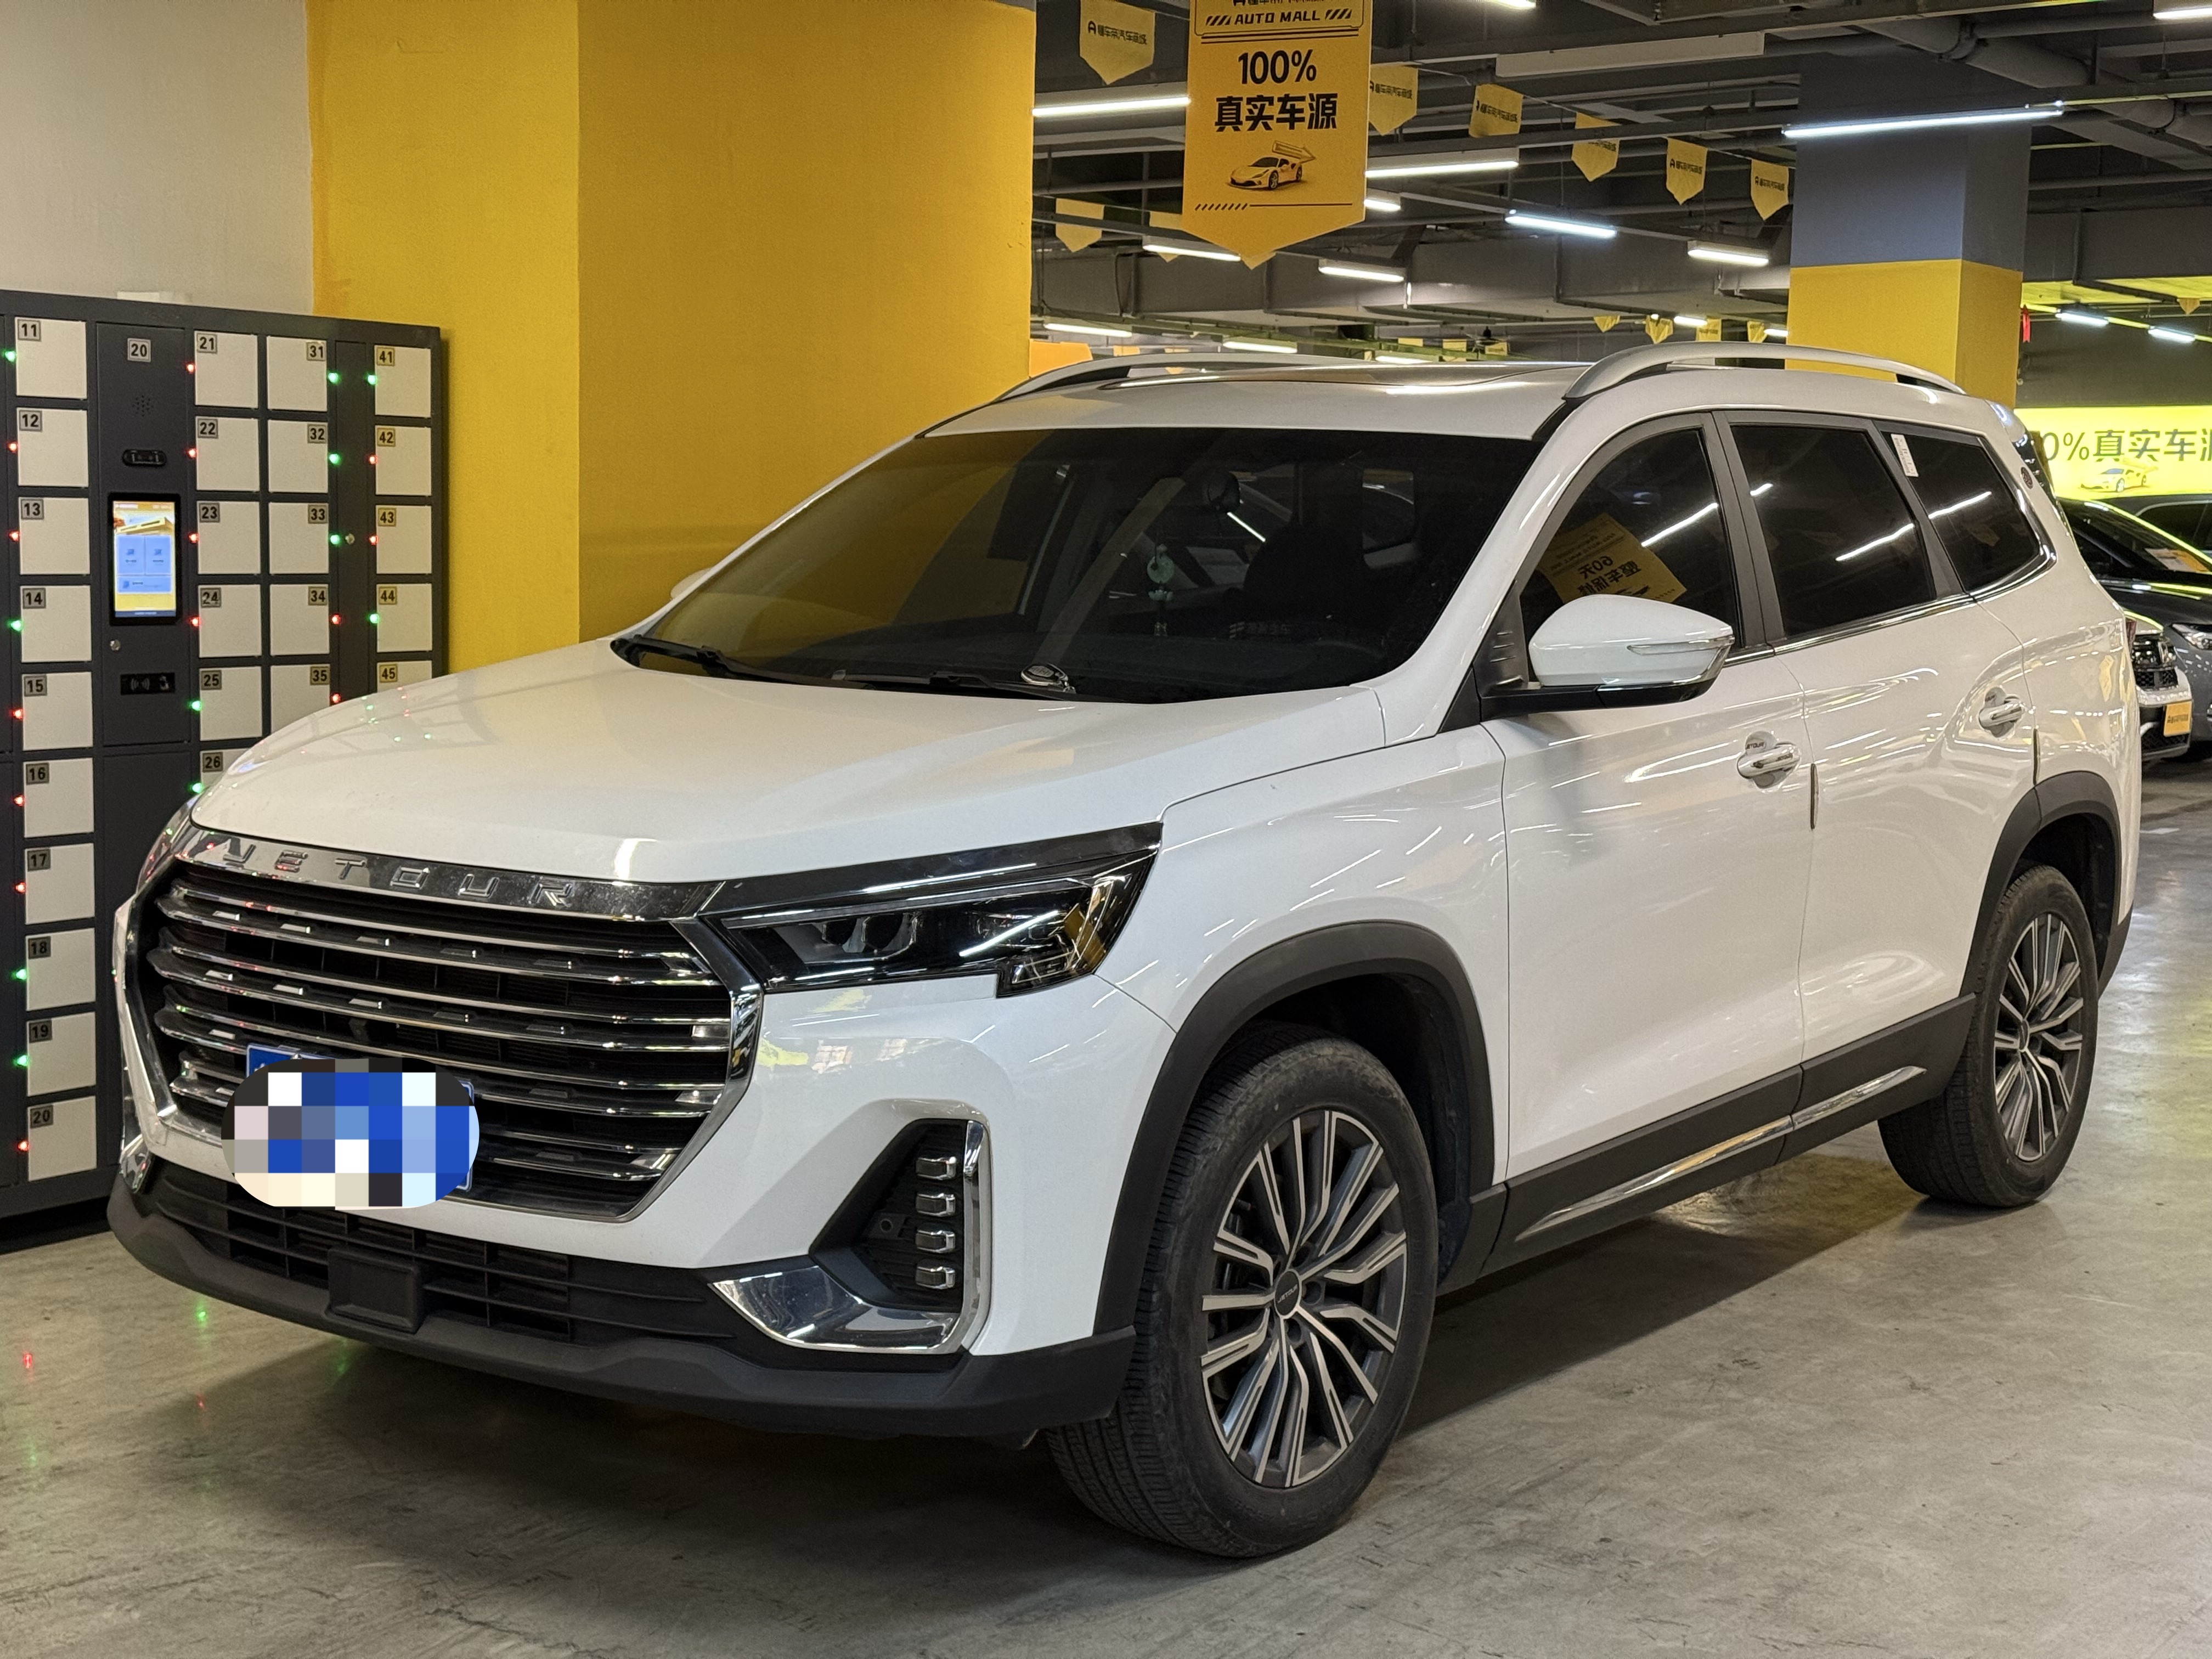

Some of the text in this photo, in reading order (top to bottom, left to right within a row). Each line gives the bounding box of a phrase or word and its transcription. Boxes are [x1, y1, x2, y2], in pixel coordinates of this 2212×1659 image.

[1234, 10, 1321, 25] AUTO MALL
[1238, 49, 1317, 84] 100%
[1214, 93, 1338, 132] 真实车源
[21, 323, 37, 337] 11
[131, 343, 148, 357] 20
[199, 336, 215, 351] 21
[309, 345, 323, 358] 31
[379, 351, 392, 363] 41
[22, 414, 39, 427] 12
[200, 422, 216, 435] 22
[310, 427, 325, 441] 32
[379, 431, 394, 444] 42
[24, 503, 41, 516] 13
[201, 506, 218, 519] 23
[311, 508, 325, 521] 33
[380, 511, 394, 523] 43
[26, 592, 43, 605] 14
[202, 591, 219, 605] 24
[311, 590, 326, 602] 34
[380, 590, 396, 602] 44
[204, 674, 220, 687] 25
[312, 669, 328, 682] 35
[381, 667, 396, 680] 45
[27, 679, 43, 693] 15
[205, 755, 221, 769] 26
[29, 767, 46, 781] 16
[31, 853, 47, 867] 17
[31, 941, 48, 955] 18
[32, 1024, 49, 1039] 19
[33, 1109, 51, 1125] 20
[1277, 1284, 1298, 1304] JETOUR
